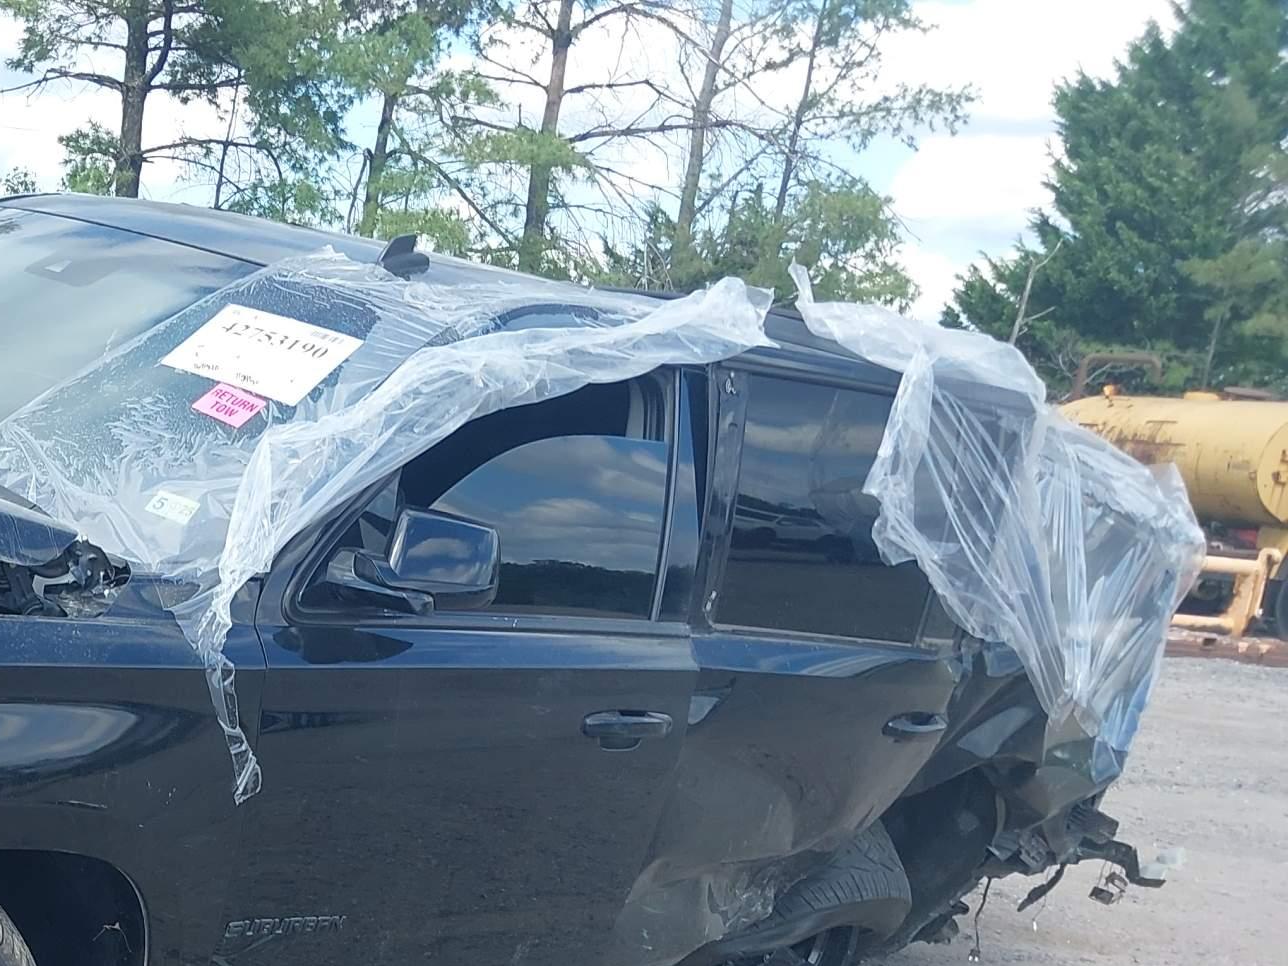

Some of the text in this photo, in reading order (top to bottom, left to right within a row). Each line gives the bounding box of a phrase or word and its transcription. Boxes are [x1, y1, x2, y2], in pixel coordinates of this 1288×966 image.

[222, 322, 329, 359] 42753190
[210, 401, 238, 417] TOW
[212, 388, 259, 412] RETURN
